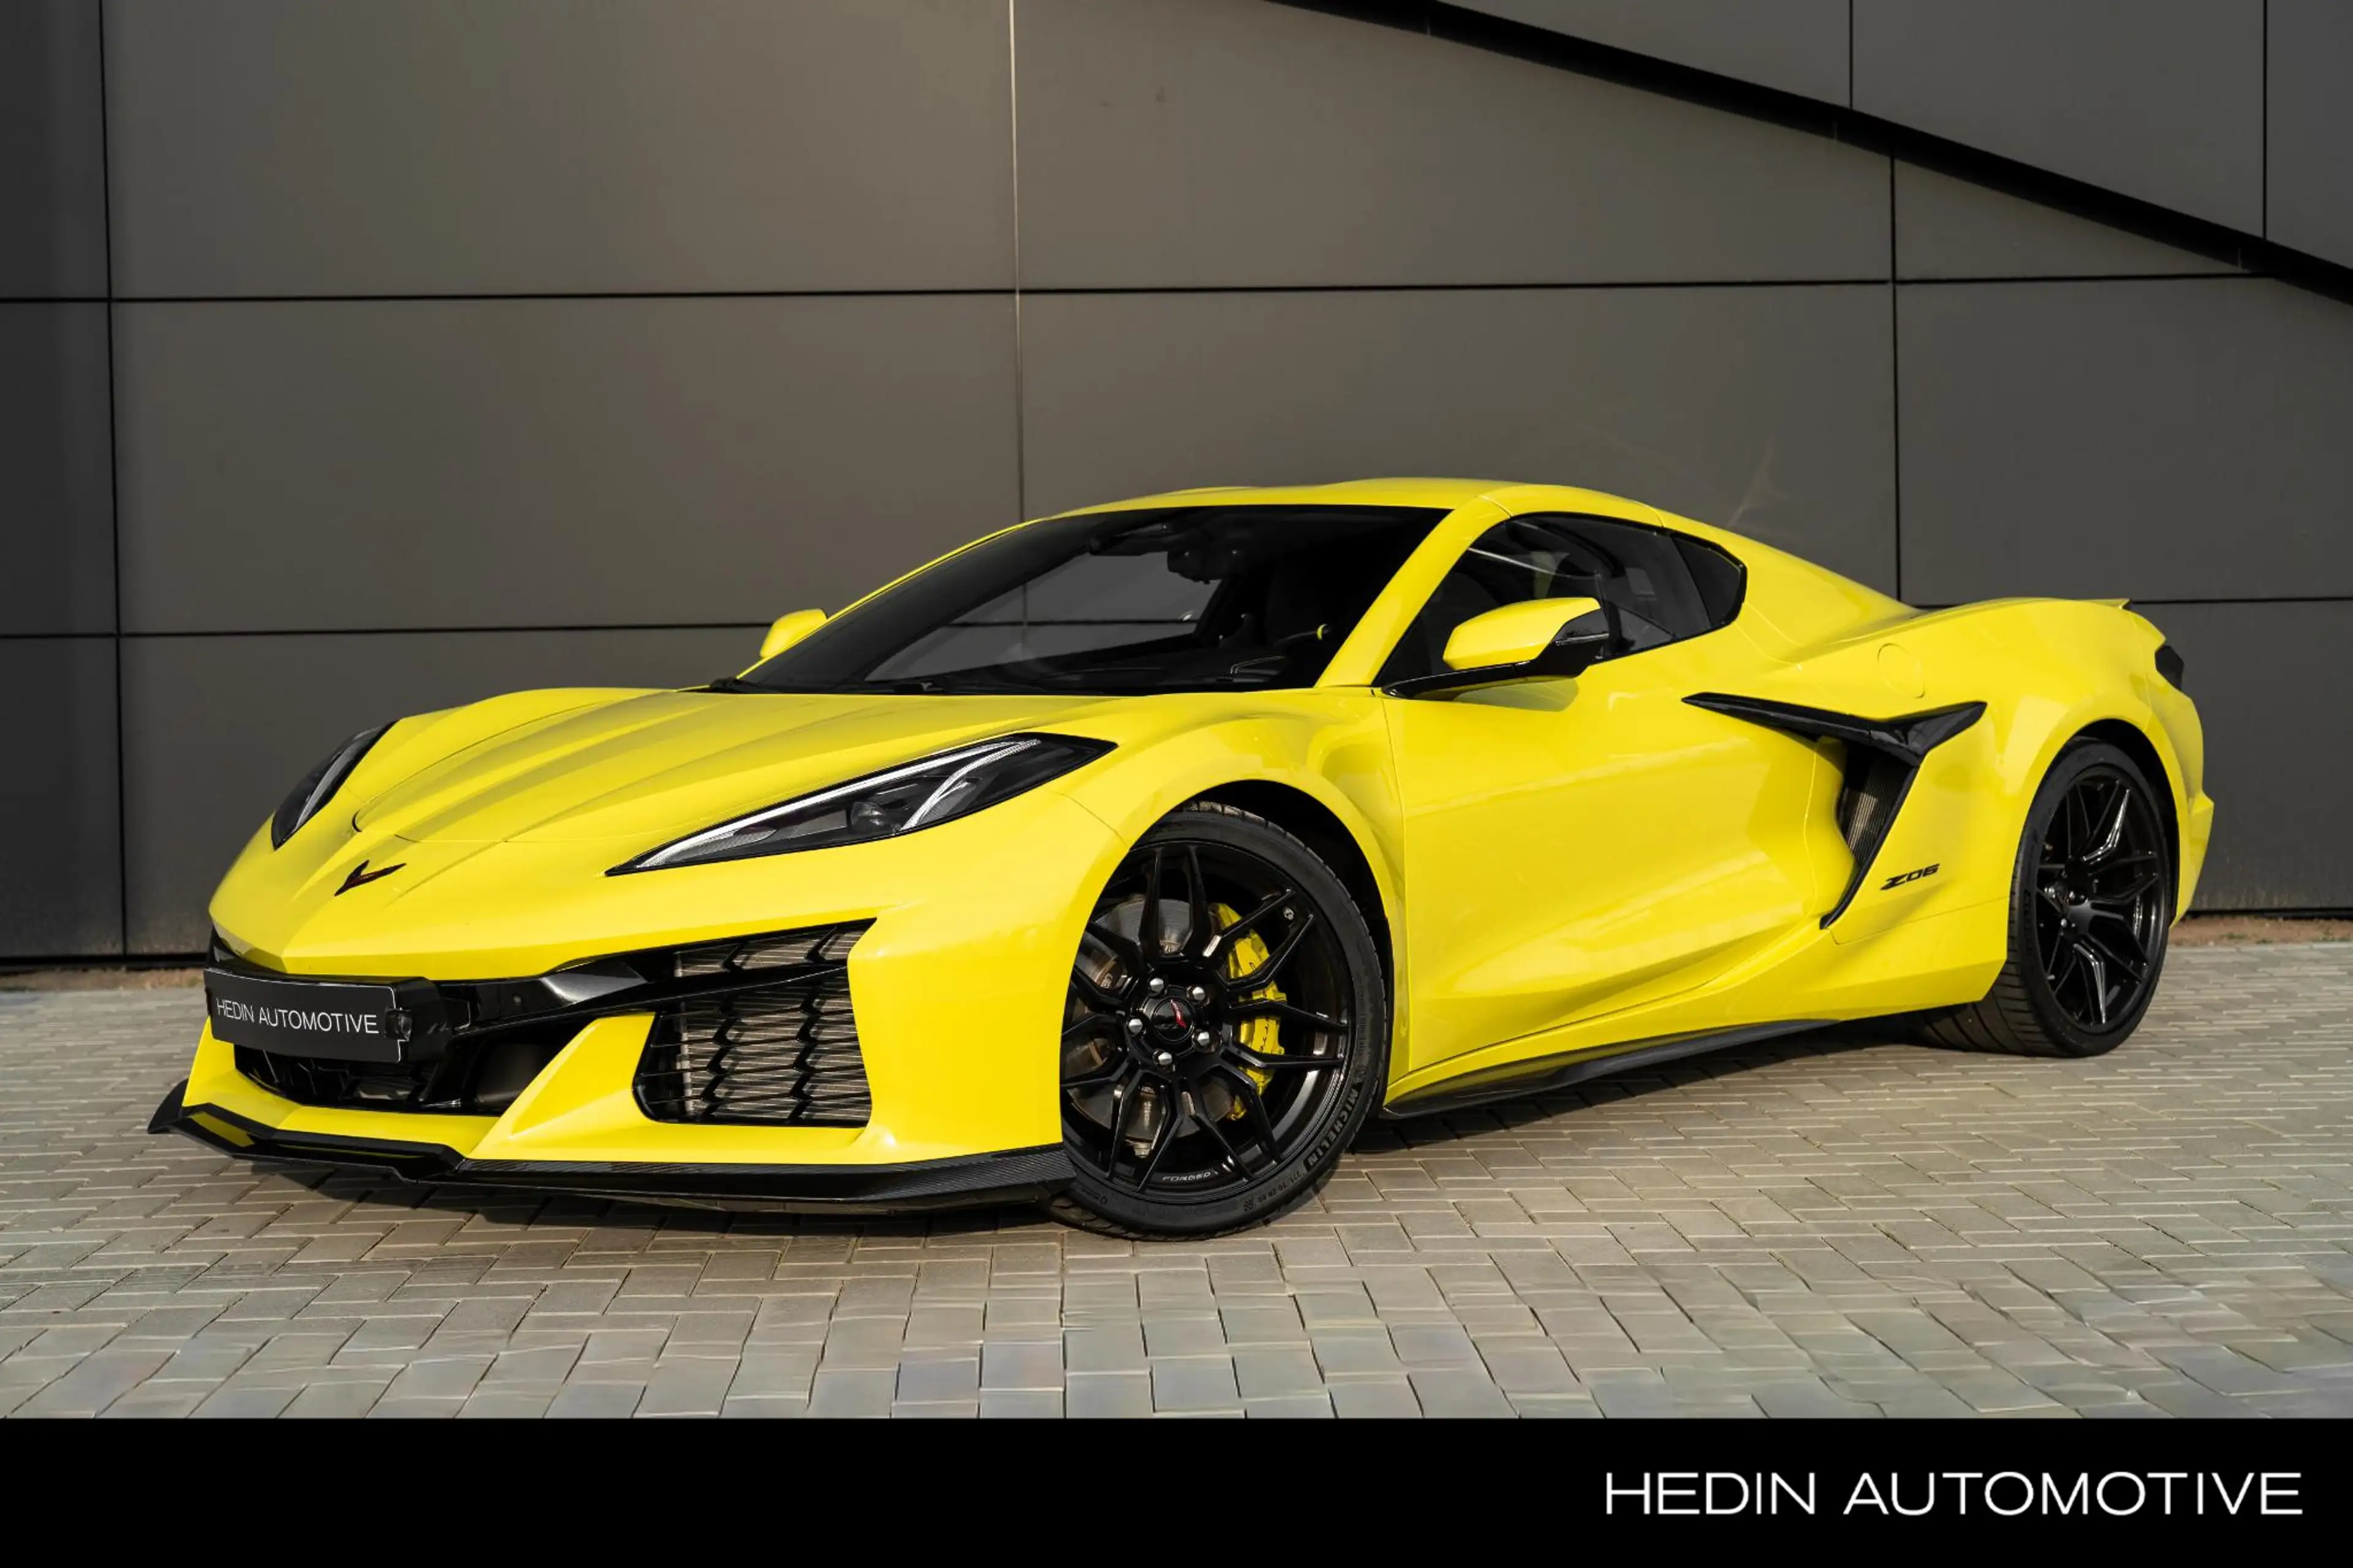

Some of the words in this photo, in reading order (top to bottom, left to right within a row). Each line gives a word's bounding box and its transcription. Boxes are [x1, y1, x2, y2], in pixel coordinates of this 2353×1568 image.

[1879, 863, 1940, 890] Z06
[216, 998, 255, 1023] HEDIN
[259, 1007, 379, 1034] AUTOMOTIVE
[1307, 1088, 1359, 1167] MICHELIN
[1162, 1171, 1211, 1182] FORGED
